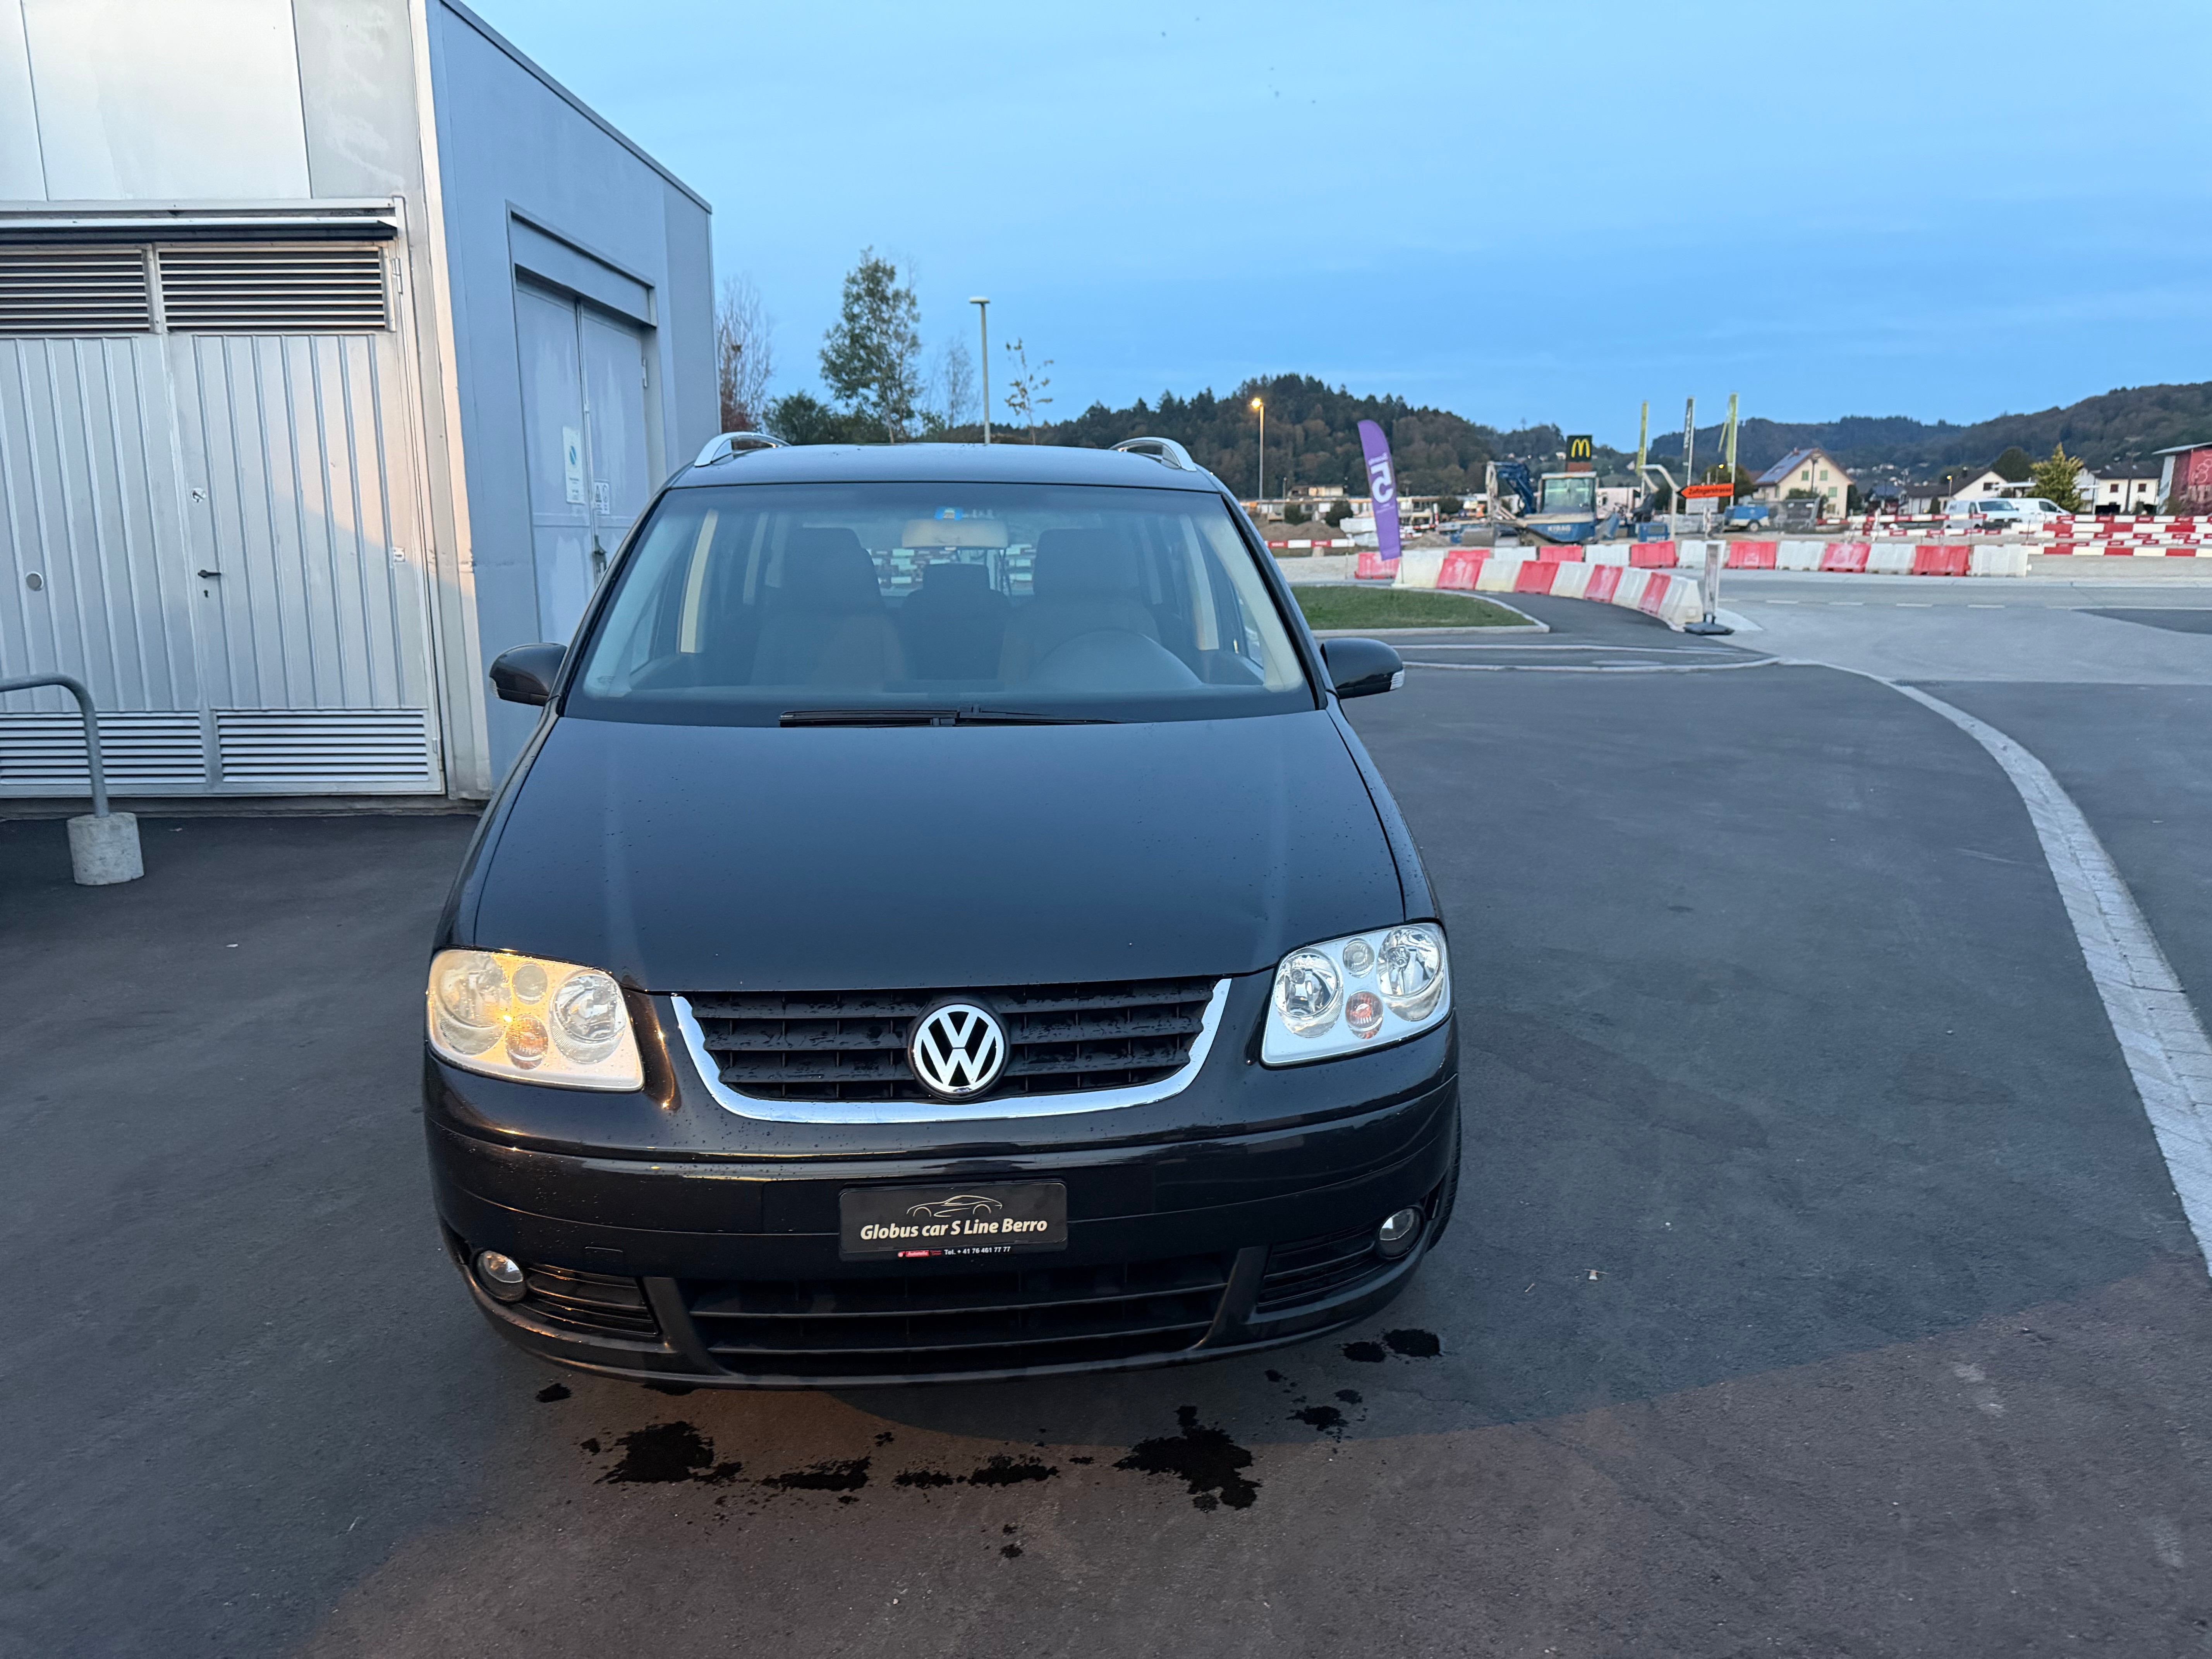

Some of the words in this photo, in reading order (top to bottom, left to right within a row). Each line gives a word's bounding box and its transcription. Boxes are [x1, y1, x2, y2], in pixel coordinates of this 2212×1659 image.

[860, 1223, 919, 1240] Globus
[922, 1224, 949, 1237] car
[950, 1220, 961, 1235] S
[963, 1219, 999, 1235] Line
[1001, 1218, 1048, 1233] Berro
